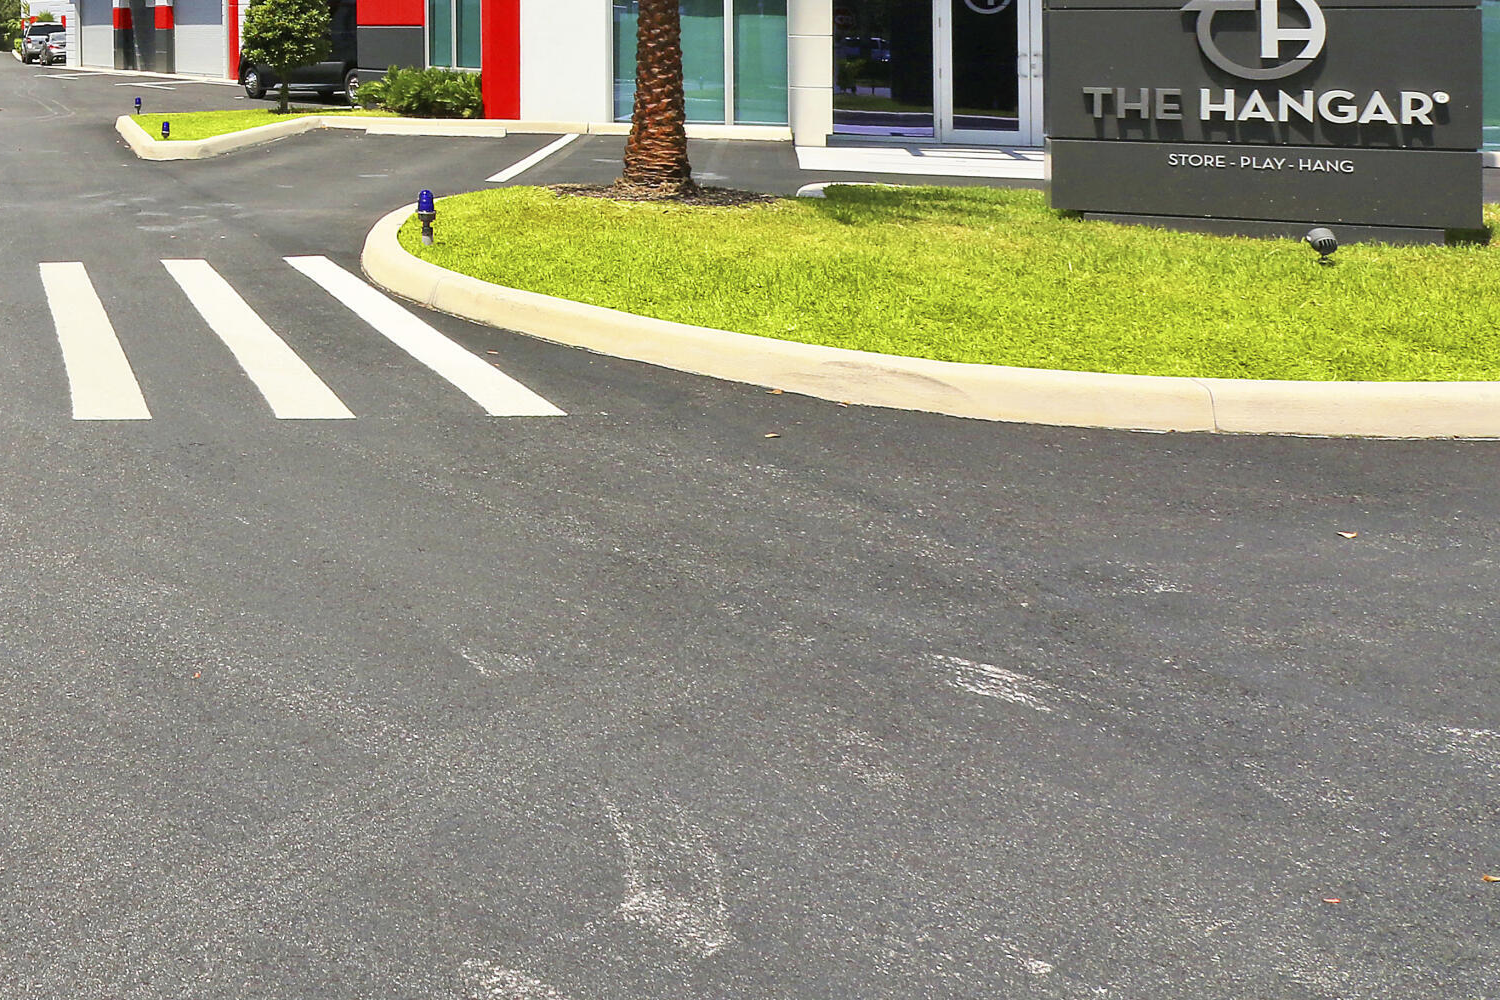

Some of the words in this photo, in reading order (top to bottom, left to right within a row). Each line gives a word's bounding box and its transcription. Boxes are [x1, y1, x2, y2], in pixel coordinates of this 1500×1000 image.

[1082, 86, 1183, 121] THE
[1168, 153, 1227, 168] STORE
[1240, 156, 1287, 171] PLAY
[1299, 158, 1355, 173] HANG
